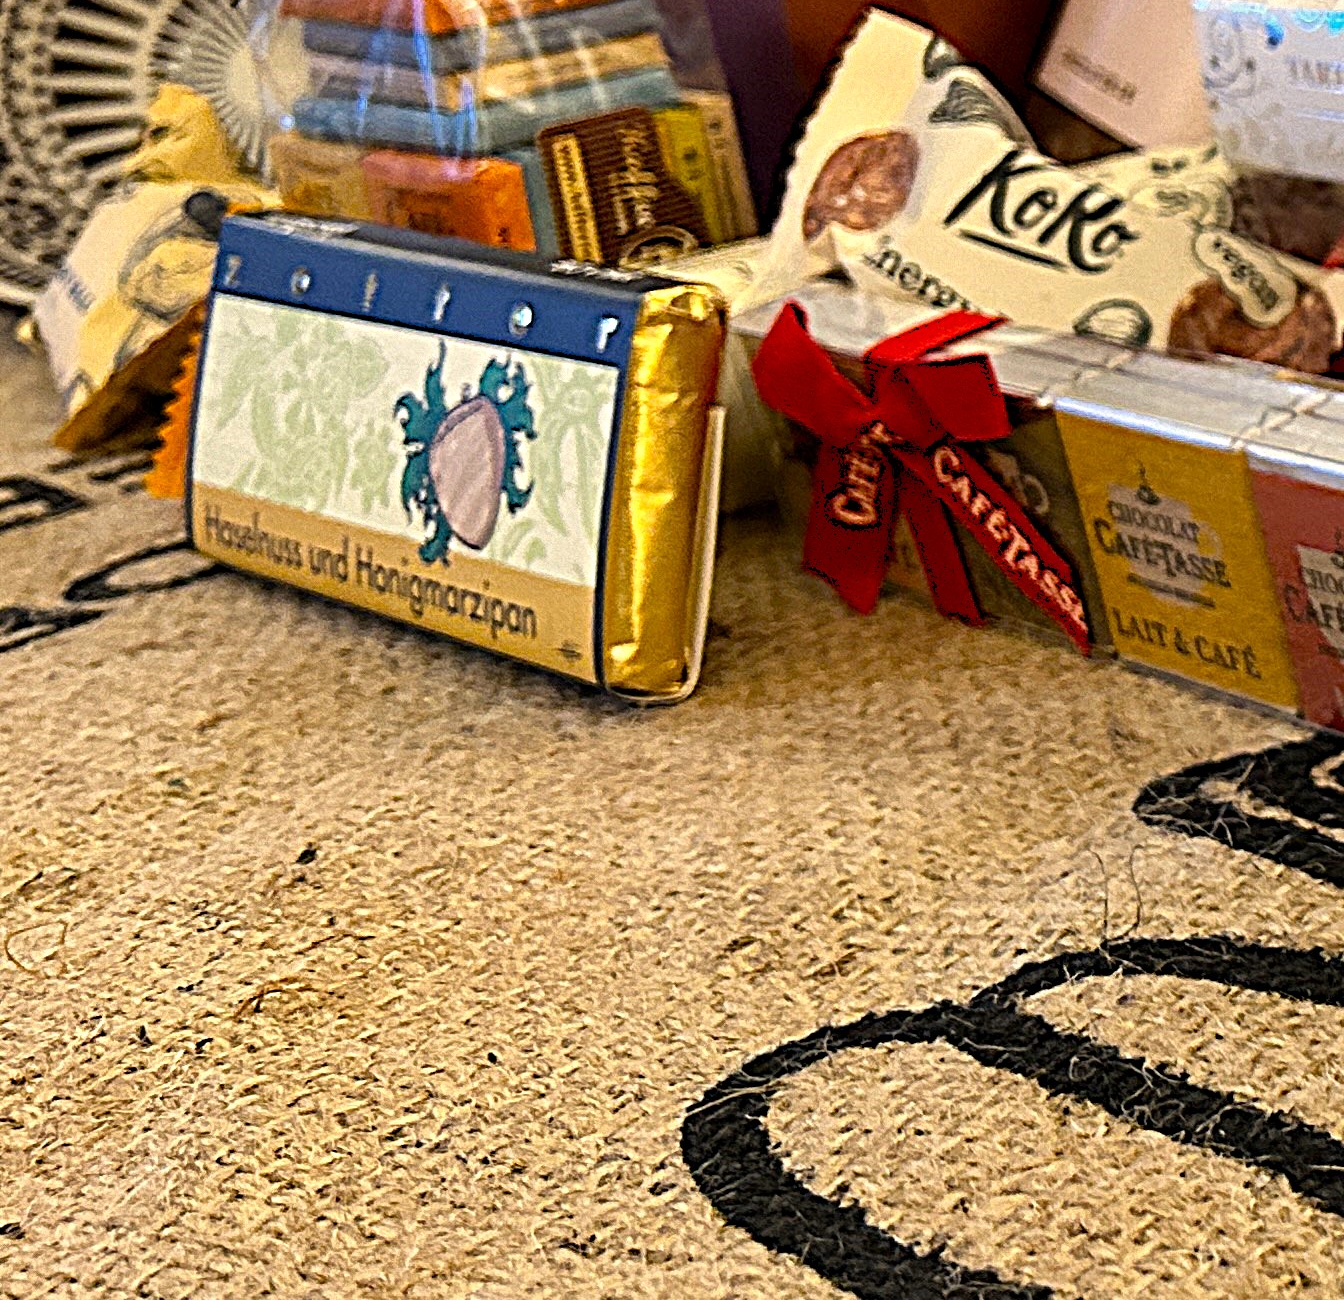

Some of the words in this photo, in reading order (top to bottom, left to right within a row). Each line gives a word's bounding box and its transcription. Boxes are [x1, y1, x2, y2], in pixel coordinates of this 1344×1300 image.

[943, 148, 1143, 274] KoRo
[1107, 500, 1200, 543] CHOCOLAT
[203, 504, 303, 570] Haselnuss
[307, 536, 349, 584] und
[355, 542, 540, 642] Honigmarzipan
[1112, 606, 1168, 648] LAIT
[1173, 625, 1190, 656] &
[1193, 634, 1262, 680] CAFÉ
